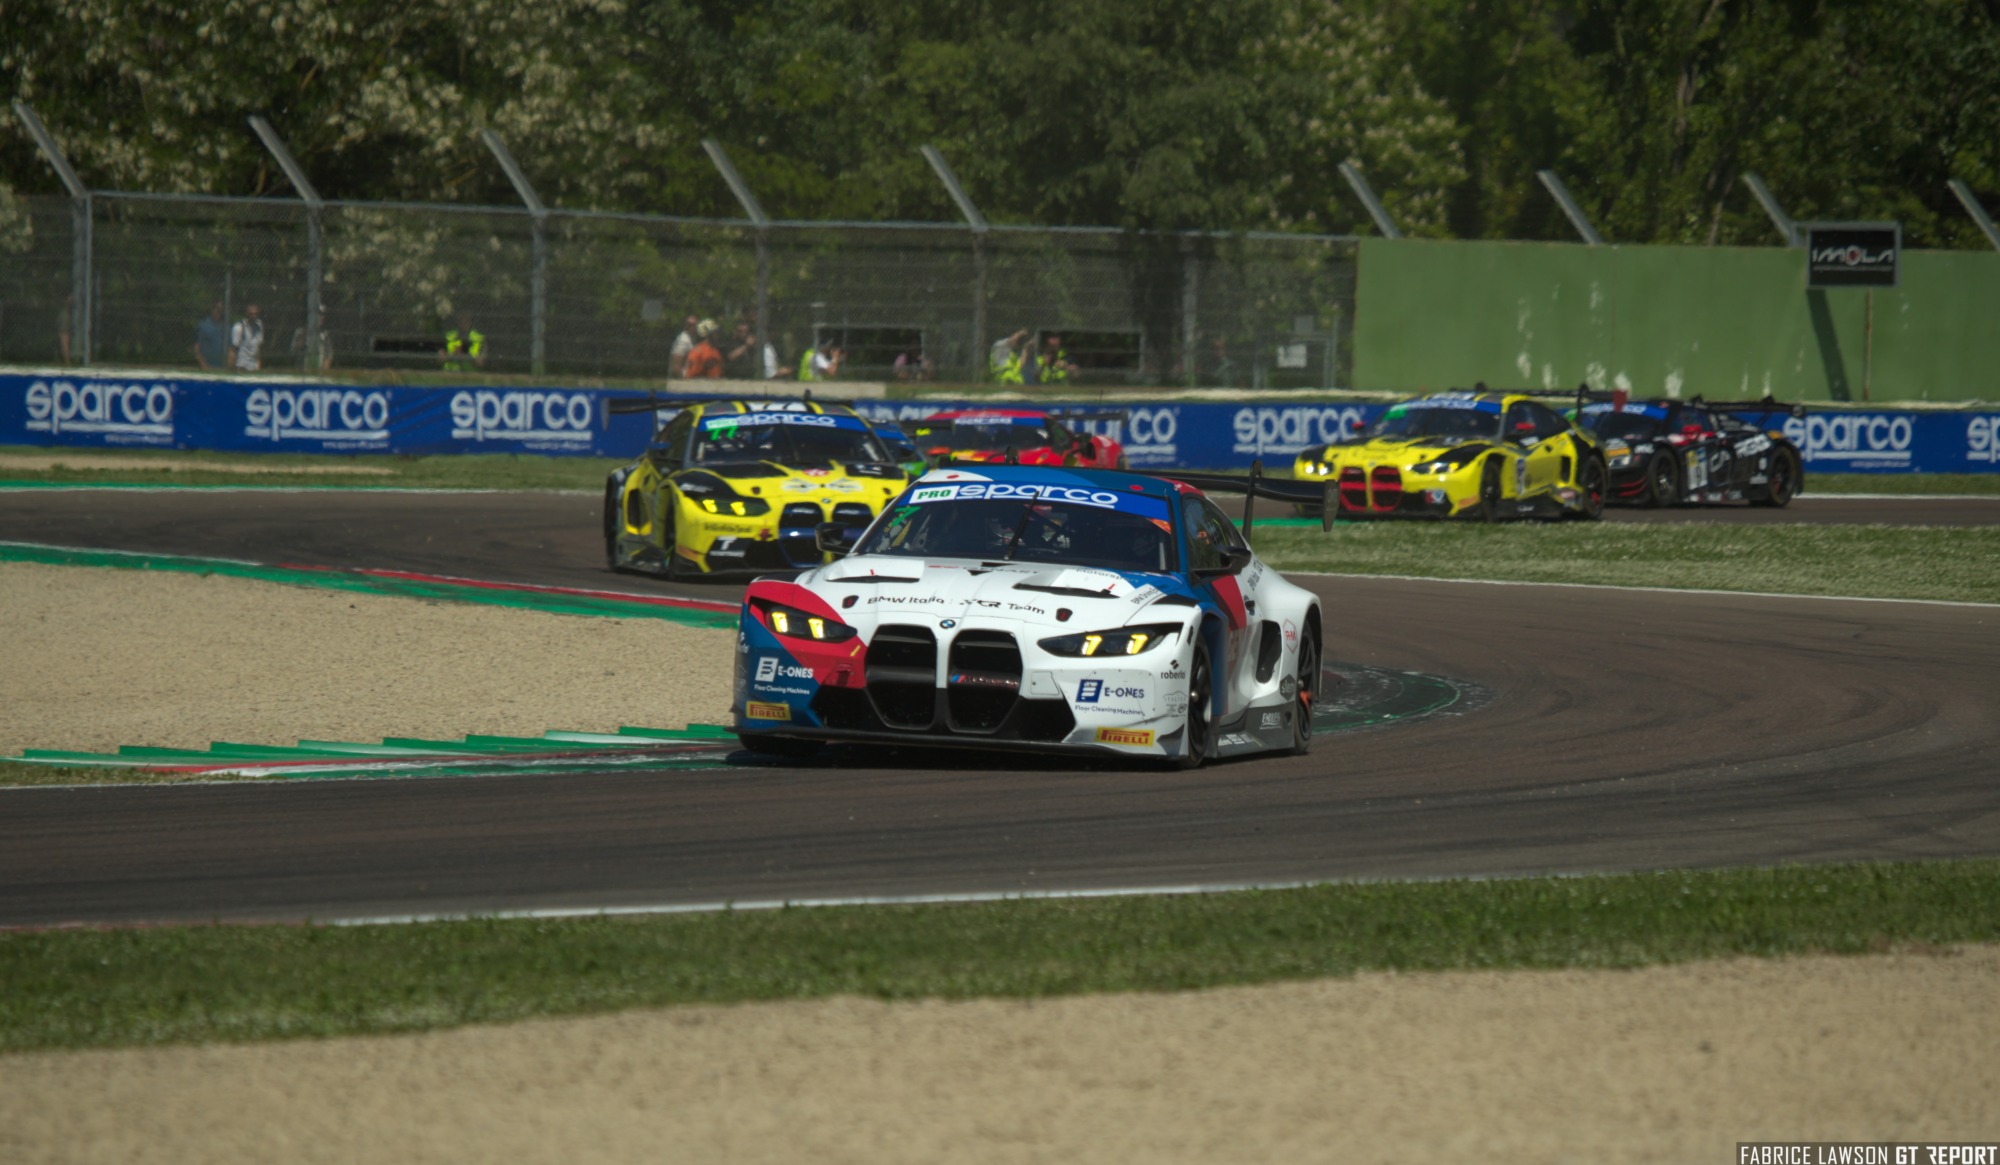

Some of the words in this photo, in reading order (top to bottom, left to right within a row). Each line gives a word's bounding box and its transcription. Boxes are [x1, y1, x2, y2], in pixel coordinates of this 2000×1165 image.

[1812, 246, 1894, 266] IMOLA
[25, 380, 173, 435] sparco
[245, 388, 389, 442] sparco
[450, 390, 592, 442] sparco
[1233, 406, 1362, 456] sparco
[1783, 415, 1913, 462] sparco
[917, 489, 952, 500] PRO
[956, 484, 1119, 507] sparco
[867, 595, 907, 604] BMW
[908, 596, 945, 604] Italia
[1008, 602, 1045, 615] Team
[777, 665, 814, 679] E-ONES
[766, 685, 787, 694] Cleaning
[786, 687, 810, 695] Machines
[1104, 687, 1145, 699] E-ONES
[1091, 706, 1117, 714] Cleaning
[1100, 729, 1150, 744] PIRELLI
